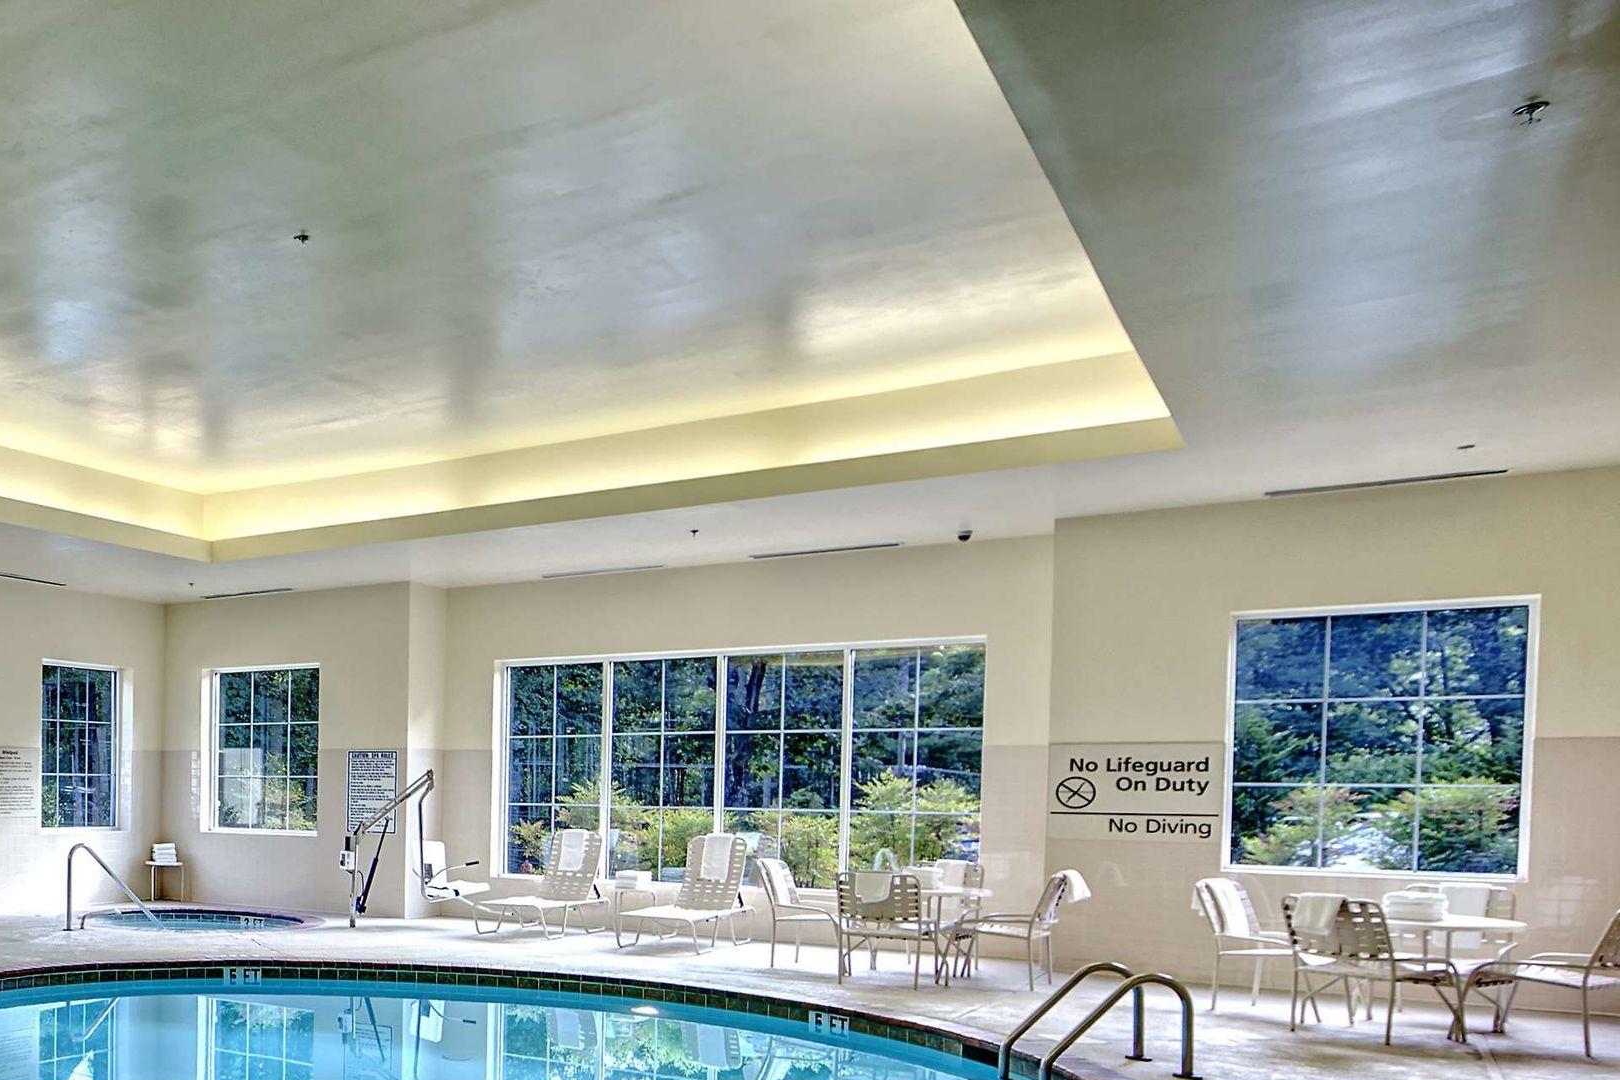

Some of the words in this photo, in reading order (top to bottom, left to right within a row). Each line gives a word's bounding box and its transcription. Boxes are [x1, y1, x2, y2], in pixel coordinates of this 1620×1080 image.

[1069, 758, 1098, 772] No
[1106, 757, 1210, 776] Lifeguard
[1116, 777, 1146, 791] On
[1156, 778, 1210, 796] Duty
[1108, 818, 1138, 833] No
[1146, 819, 1212, 839] Diving
[830, 1015, 848, 1030] FT
